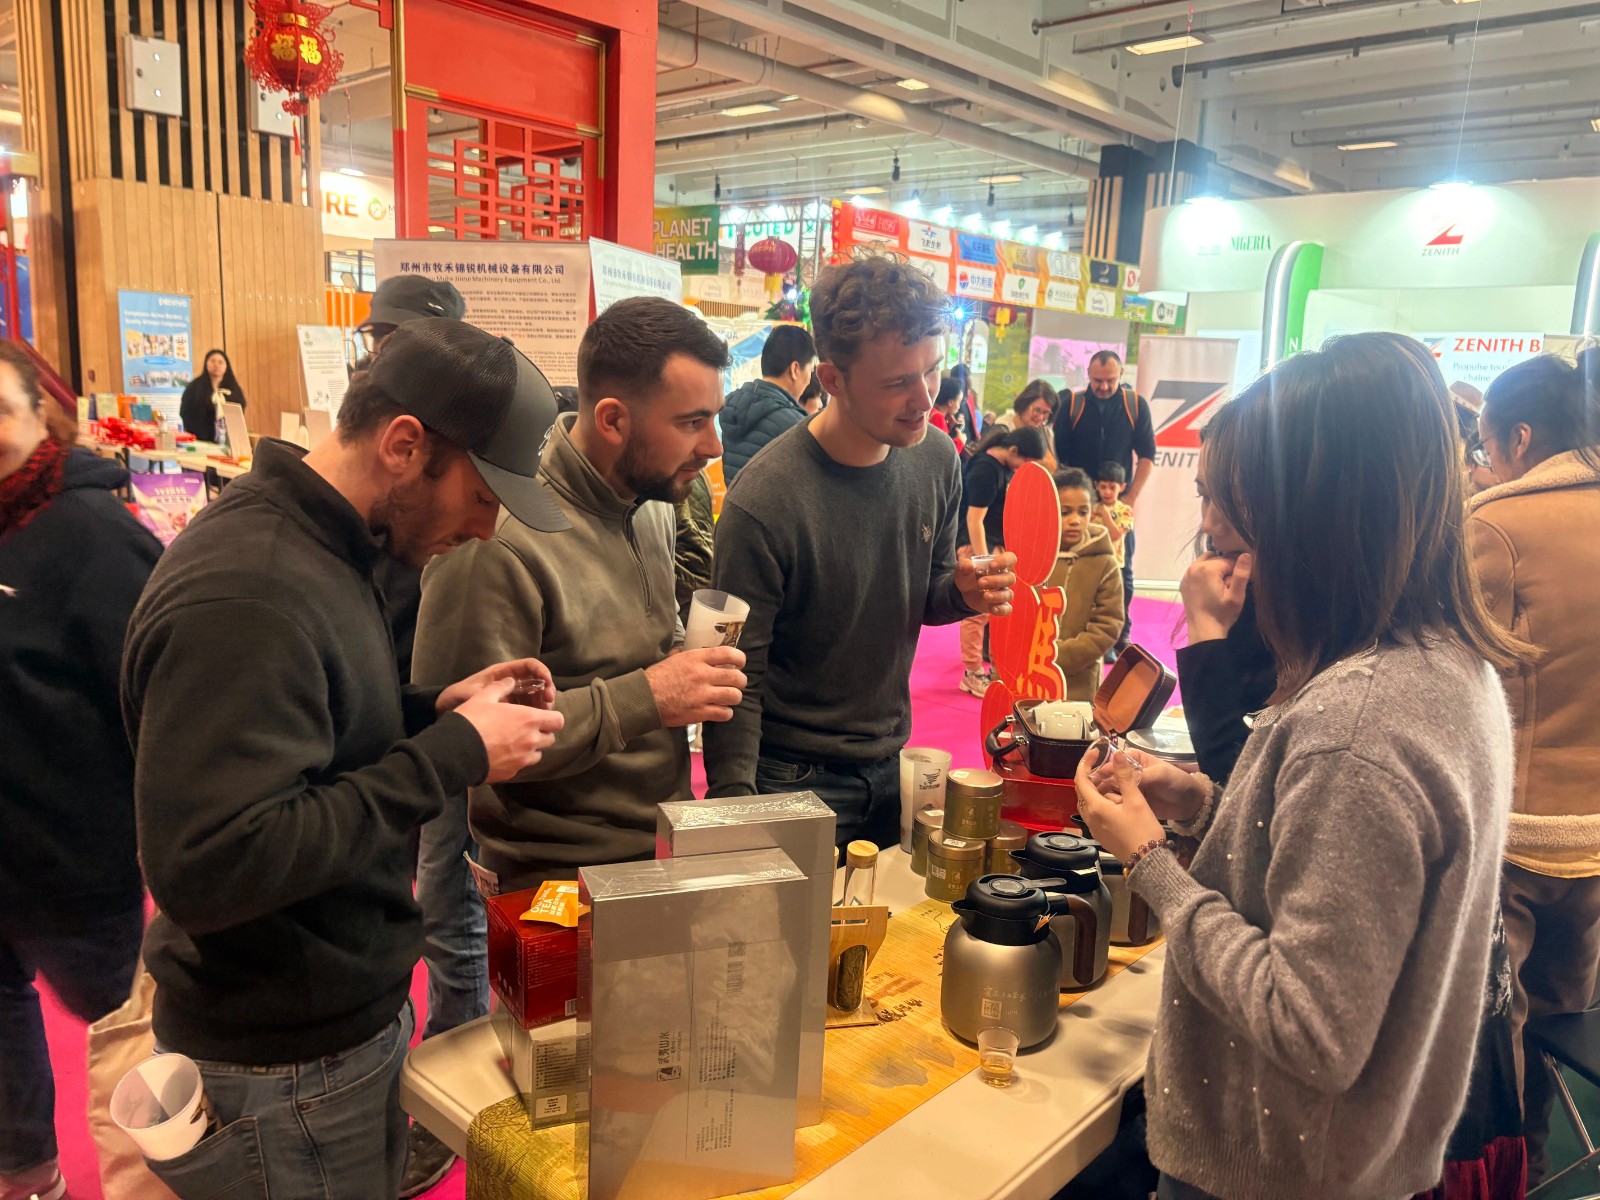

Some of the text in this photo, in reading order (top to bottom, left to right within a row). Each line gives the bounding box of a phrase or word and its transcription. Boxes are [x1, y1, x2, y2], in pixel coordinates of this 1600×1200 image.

[299, 34, 322, 65] 福
[653, 217, 712, 238] PLANET
[656, 240, 717, 260] HEALTH
[1231, 235, 1271, 251] NIGERIA
[1421, 247, 1460, 257] ZENITH
[1453, 338, 1524, 353] ZENITH
[1453, 362, 1489, 372] Propulse
[1154, 451, 1198, 468] ENIT
[539, 898, 554, 914] TEA
